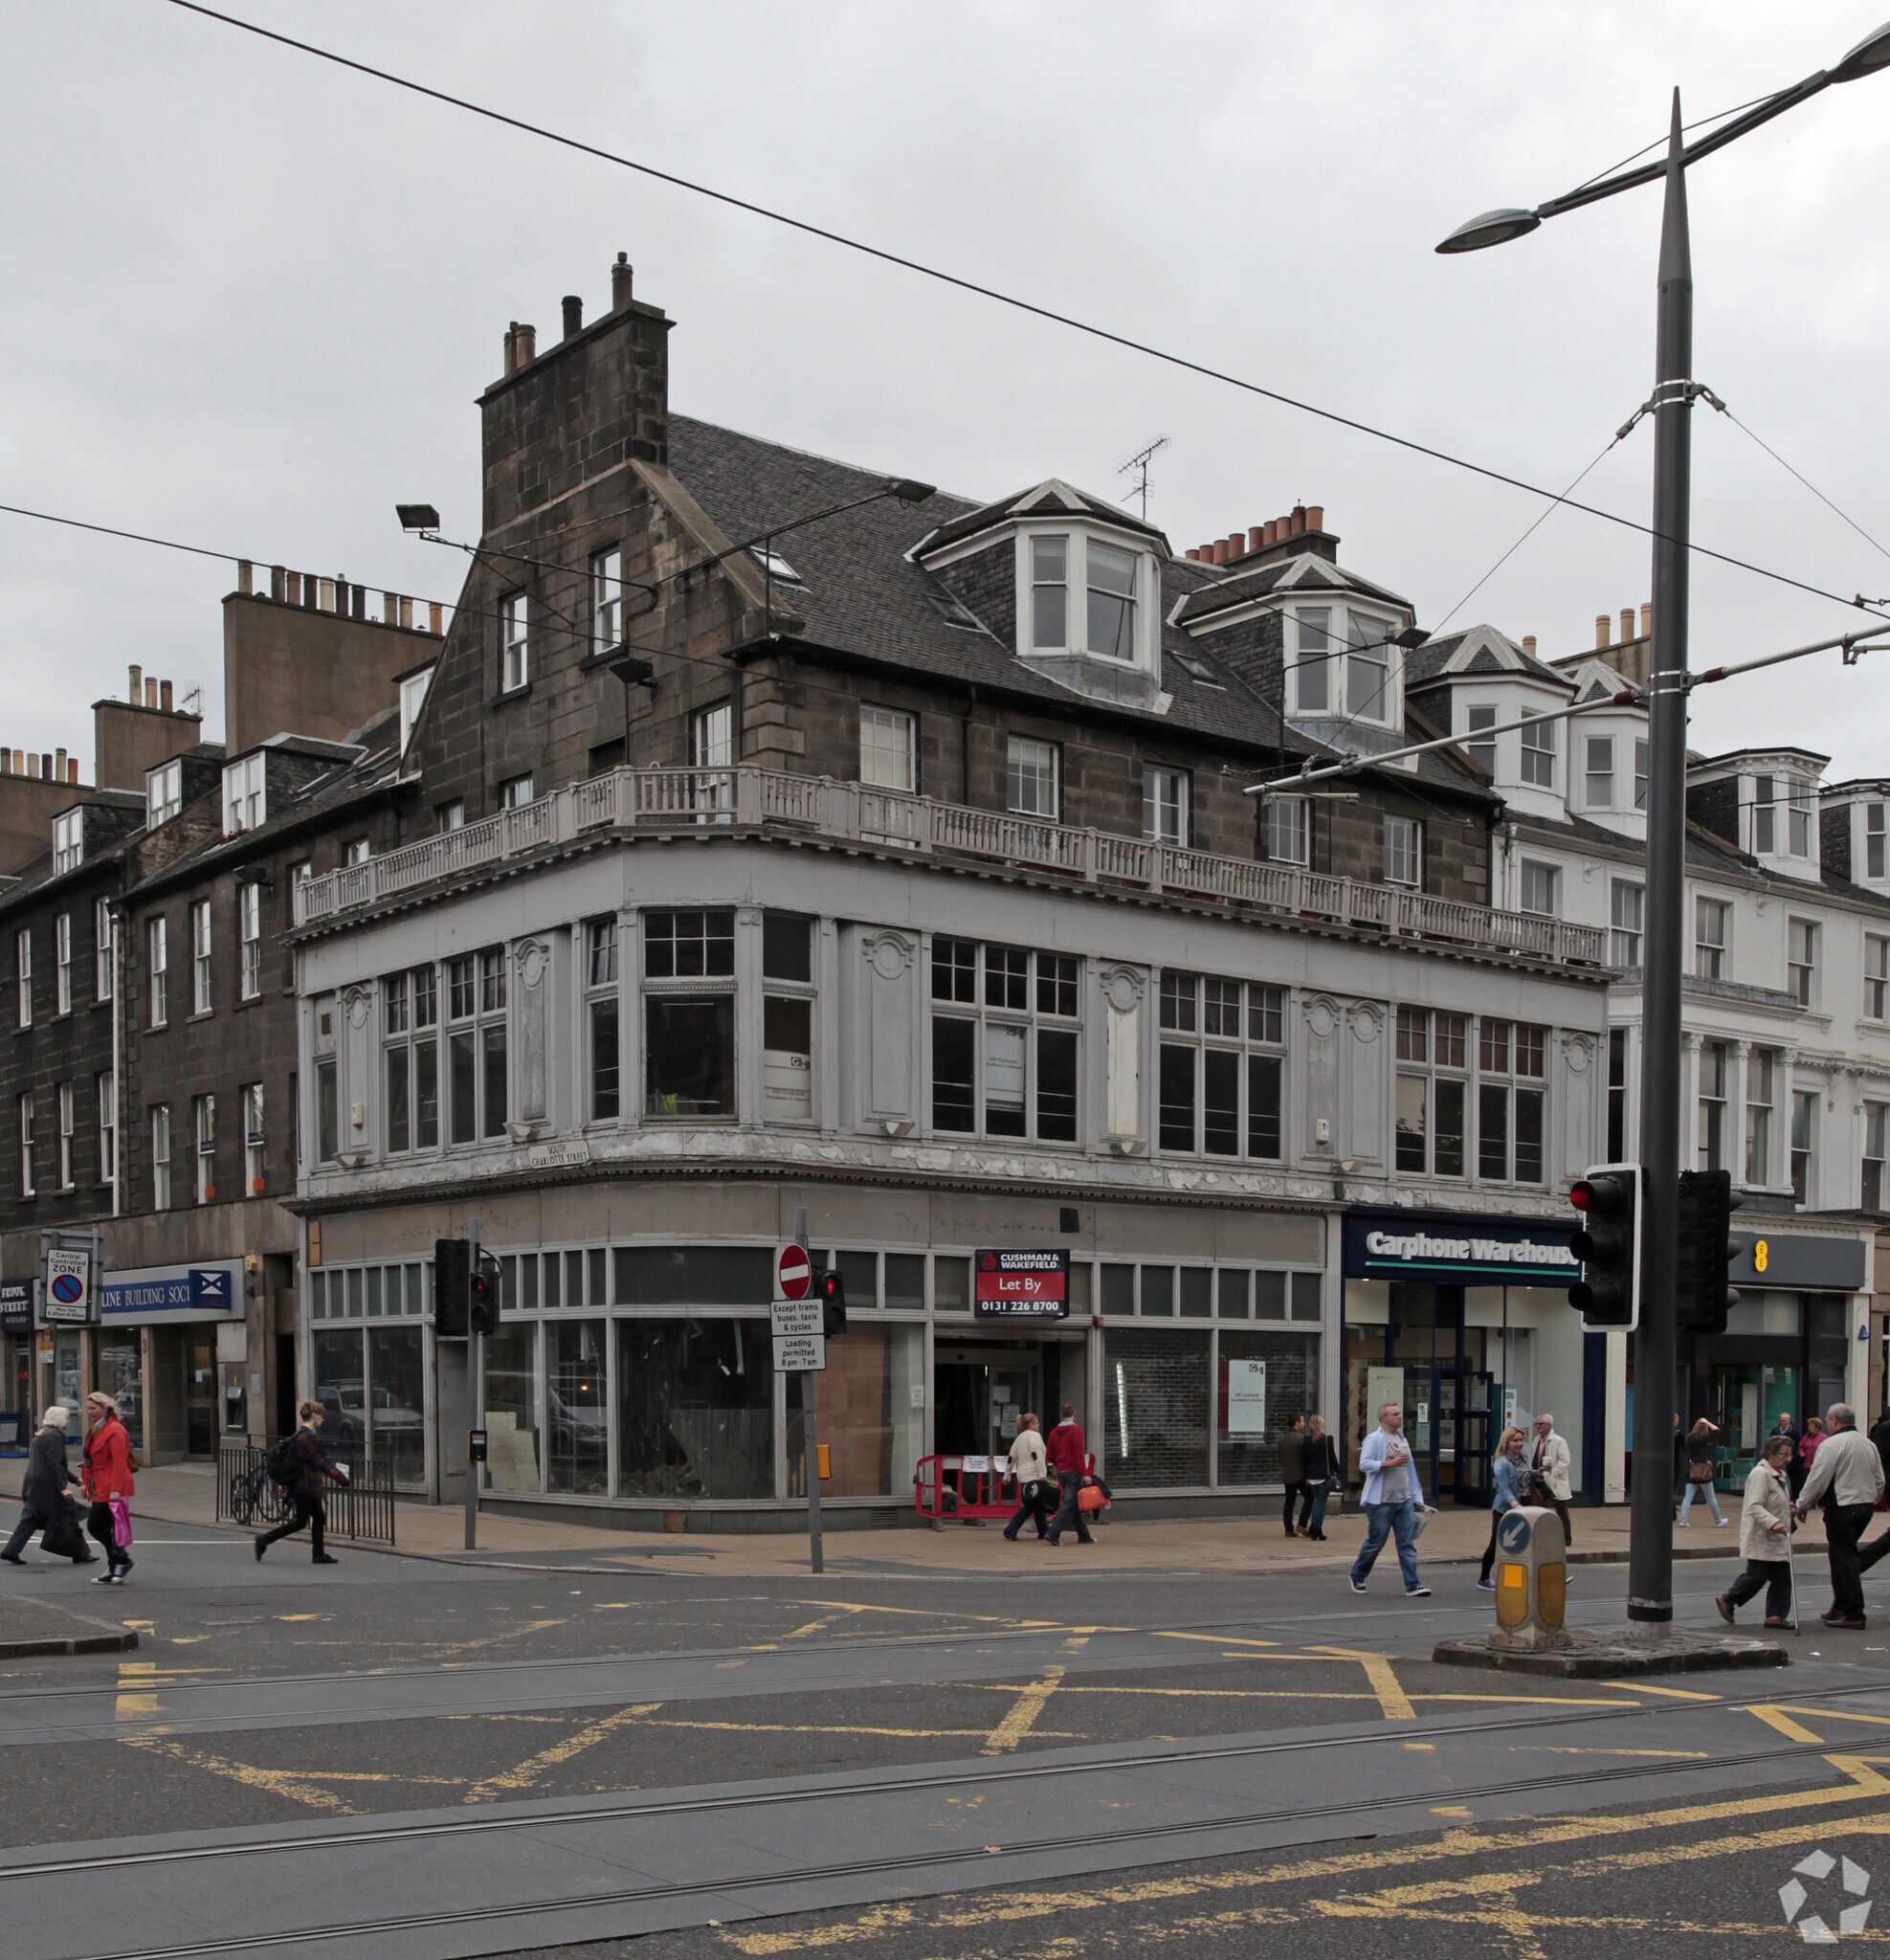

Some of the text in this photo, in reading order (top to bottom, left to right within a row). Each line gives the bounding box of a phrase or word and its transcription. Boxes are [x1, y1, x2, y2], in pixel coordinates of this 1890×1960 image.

[548, 1145, 566, 1154] SOUTH
[532, 1152, 587, 1166] CHARLOTTE STREET
[1366, 1231, 1471, 1260] Carphone
[53, 1264, 83, 1275] ZONE
[999, 1278, 1042, 1294] Let By
[125, 1287, 165, 1305] BUILDING
[773, 1304, 797, 1313] Except
[982, 1302, 1059, 1310] 0131 226 8700
[790, 1323, 812, 1331] cycles
[782, 1348, 815, 1357] permitted
